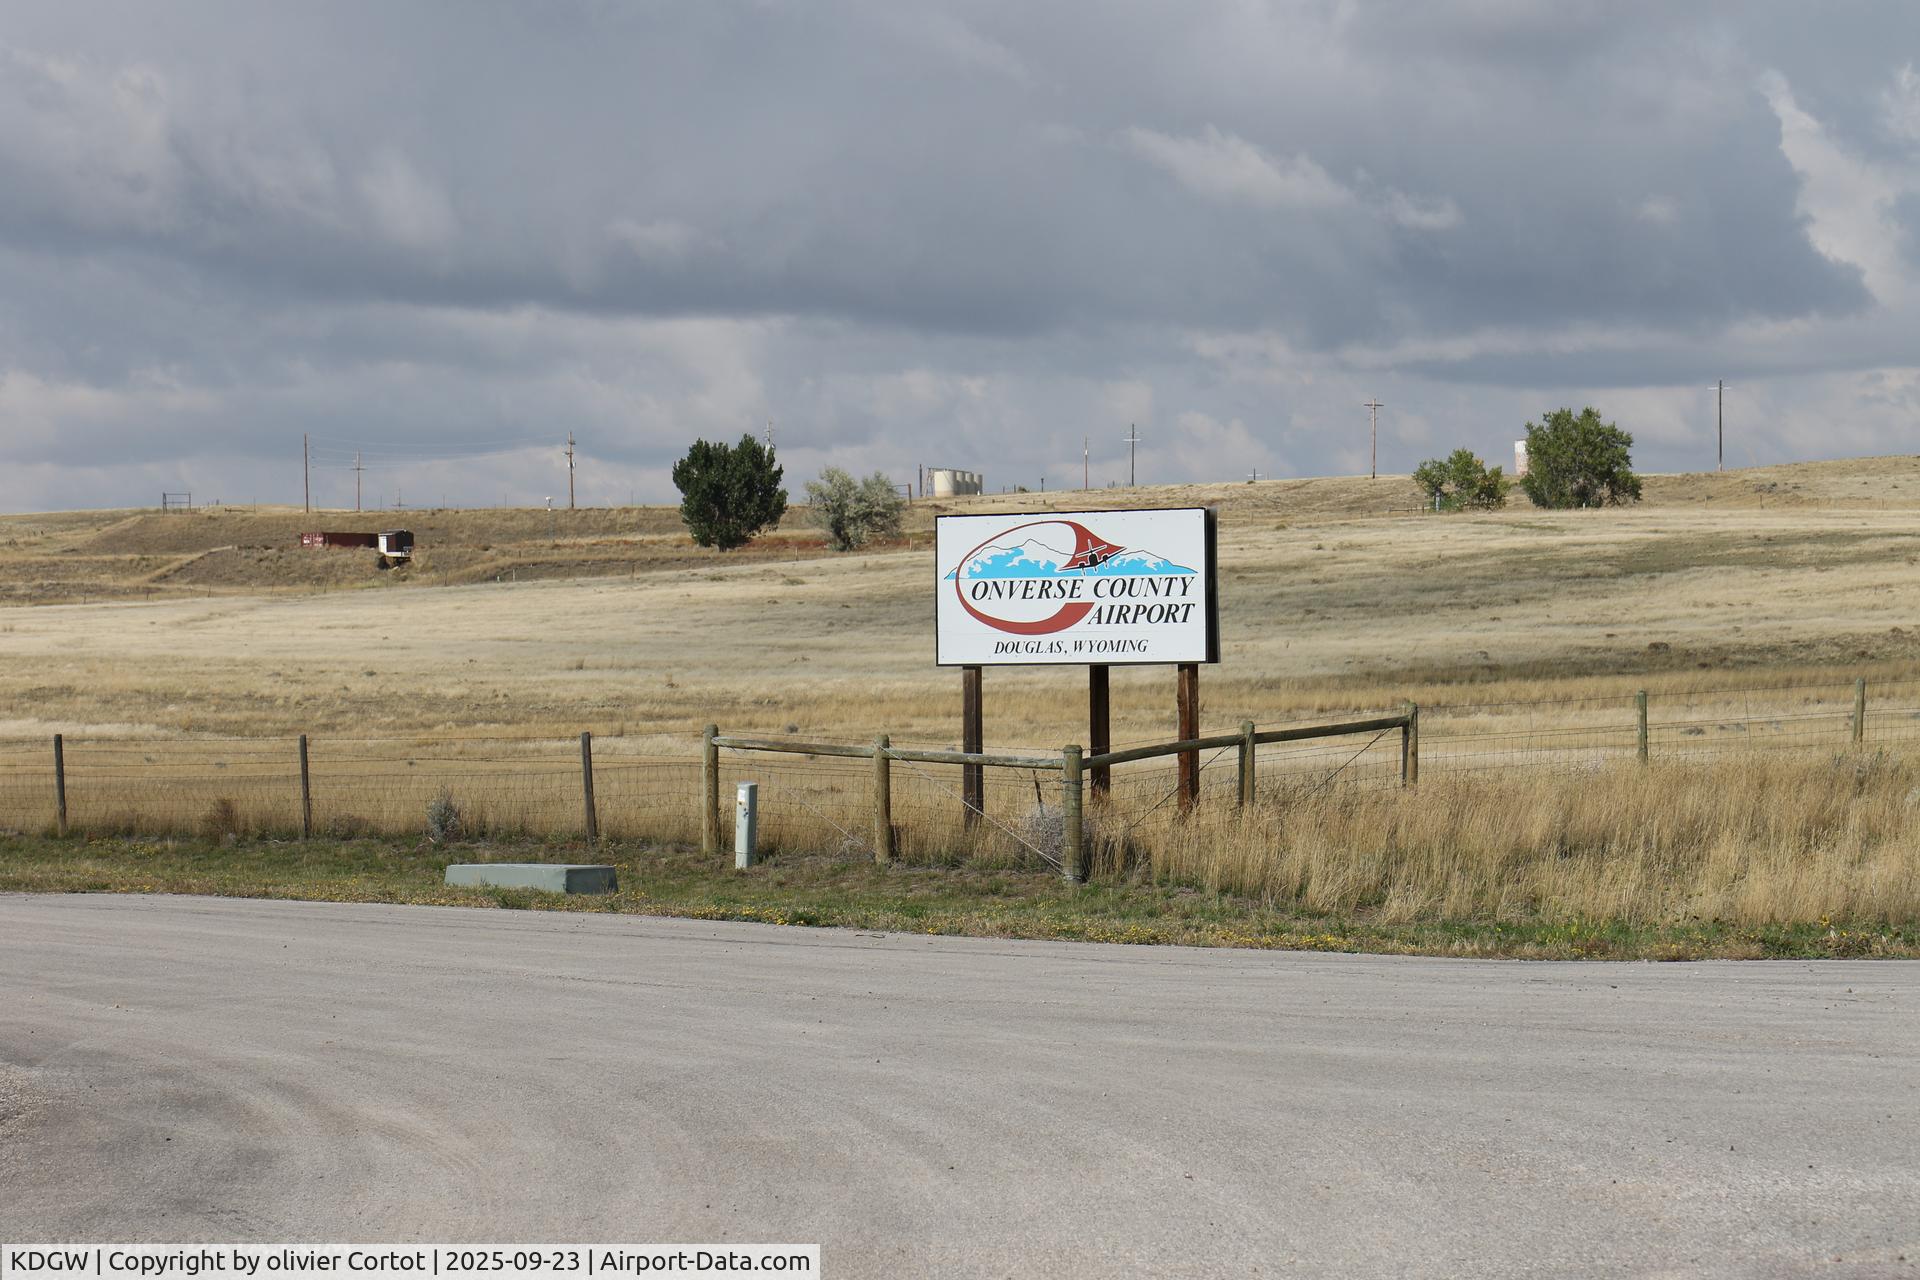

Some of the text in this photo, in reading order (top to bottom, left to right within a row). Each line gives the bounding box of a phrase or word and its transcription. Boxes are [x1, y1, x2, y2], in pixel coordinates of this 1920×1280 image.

[1093, 576, 1196, 599] COUNTY
[1087, 603, 1196, 625] AIRPORT
[994, 639, 1149, 655] DOUGLAS, WYOMING
